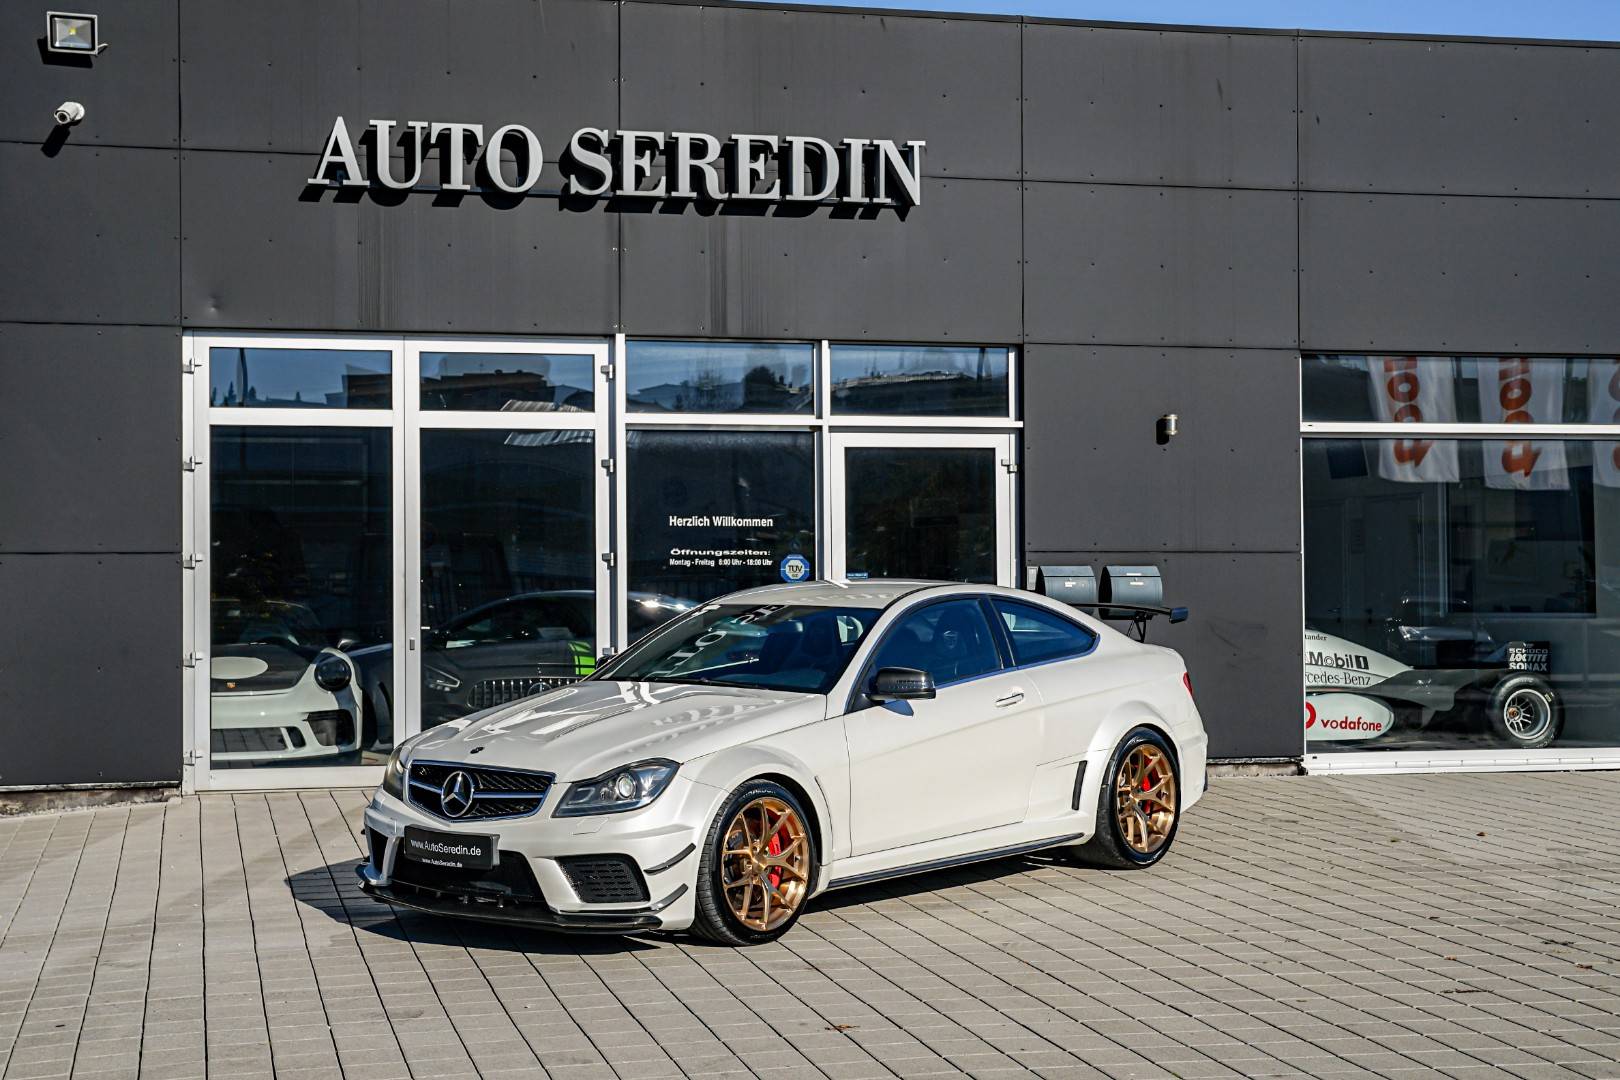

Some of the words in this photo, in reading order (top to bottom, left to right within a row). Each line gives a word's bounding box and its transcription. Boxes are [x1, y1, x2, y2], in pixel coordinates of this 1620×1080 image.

[307, 116, 544, 193] AUTO
[569, 127, 926, 206] SEREDIN
[669, 515, 710, 527] Herzlich
[712, 515, 773, 527] Willkommen
[670, 548, 771, 557] Öffnungszeiten:
[669, 558, 691, 567] Montag
[695, 558, 715, 567] Freitag
[718, 558, 731, 566] 8:00
[731, 558, 743, 566] Uhr
[746, 558, 761, 566] 18:00
[762, 558, 773, 566] Uhr
[1304, 633, 1328, 641] tander
[1309, 651, 1354, 669] Mobil
[1509, 653, 1548, 662] LOCTITE
[1508, 662, 1548, 671] SONAX
[1304, 671, 1371, 686] cedes-Benz
[1320, 715, 1383, 732] vodafone
[410, 839, 482, 856] www.AutoSeredin.de
